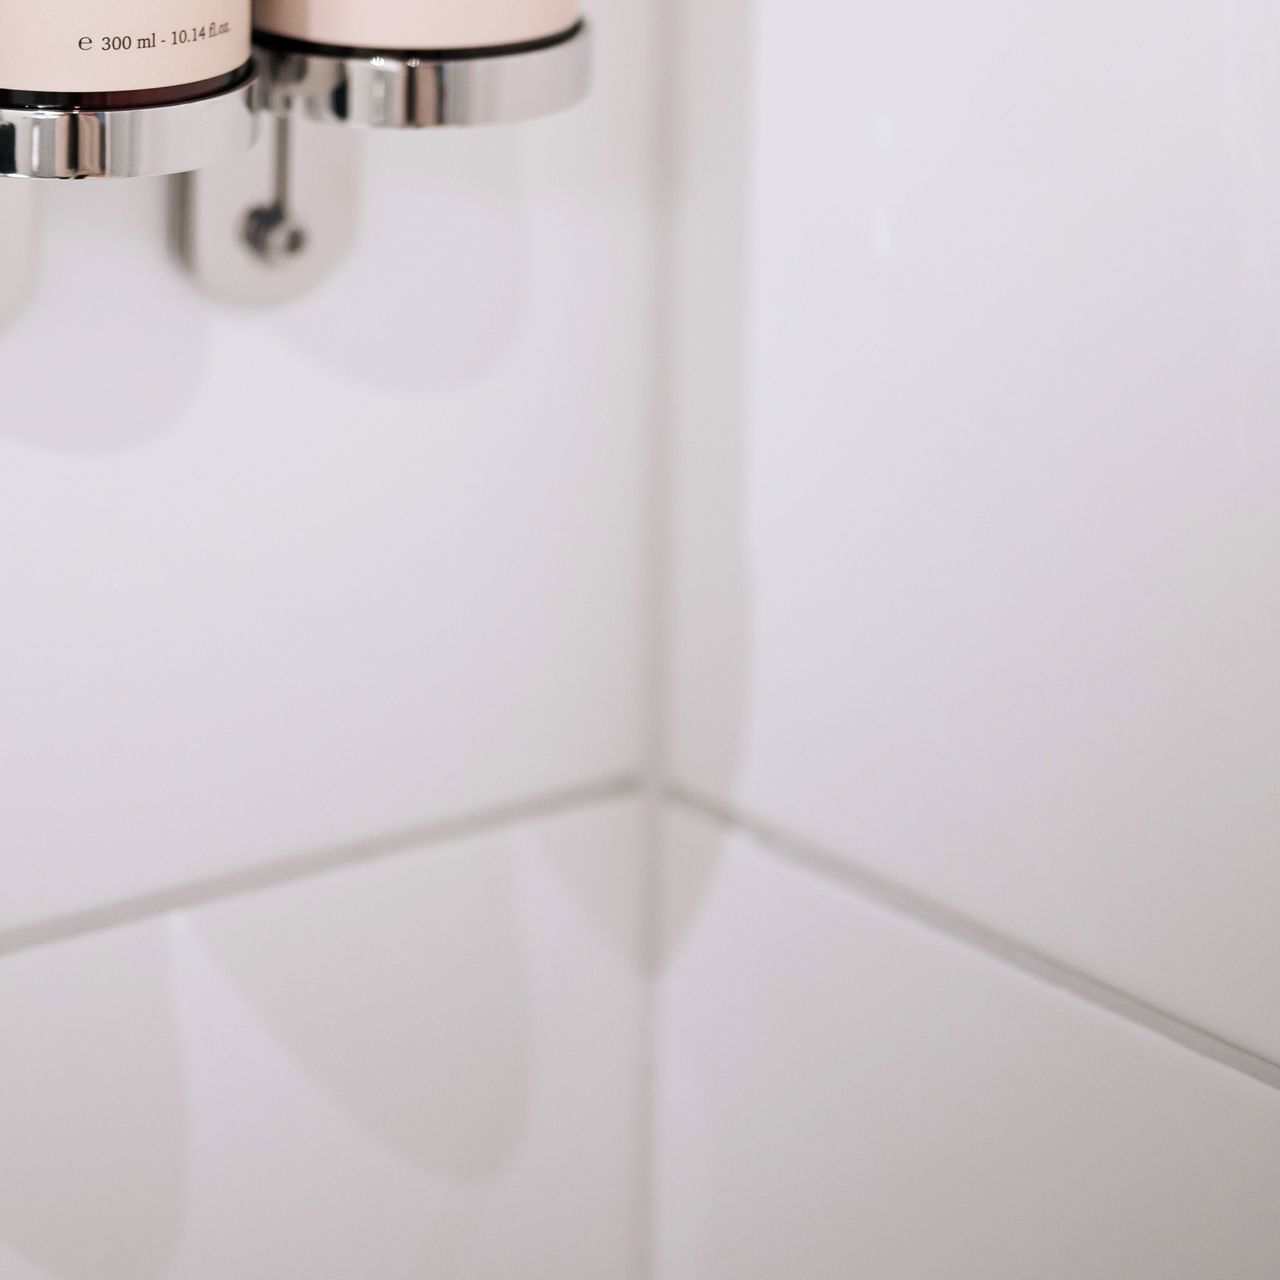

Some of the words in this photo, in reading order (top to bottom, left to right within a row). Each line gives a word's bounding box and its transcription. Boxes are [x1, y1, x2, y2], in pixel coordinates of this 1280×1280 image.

[101, 36, 132, 51] 300
[137, 33, 156, 49] ml
[171, 26, 206, 45] 10.14
